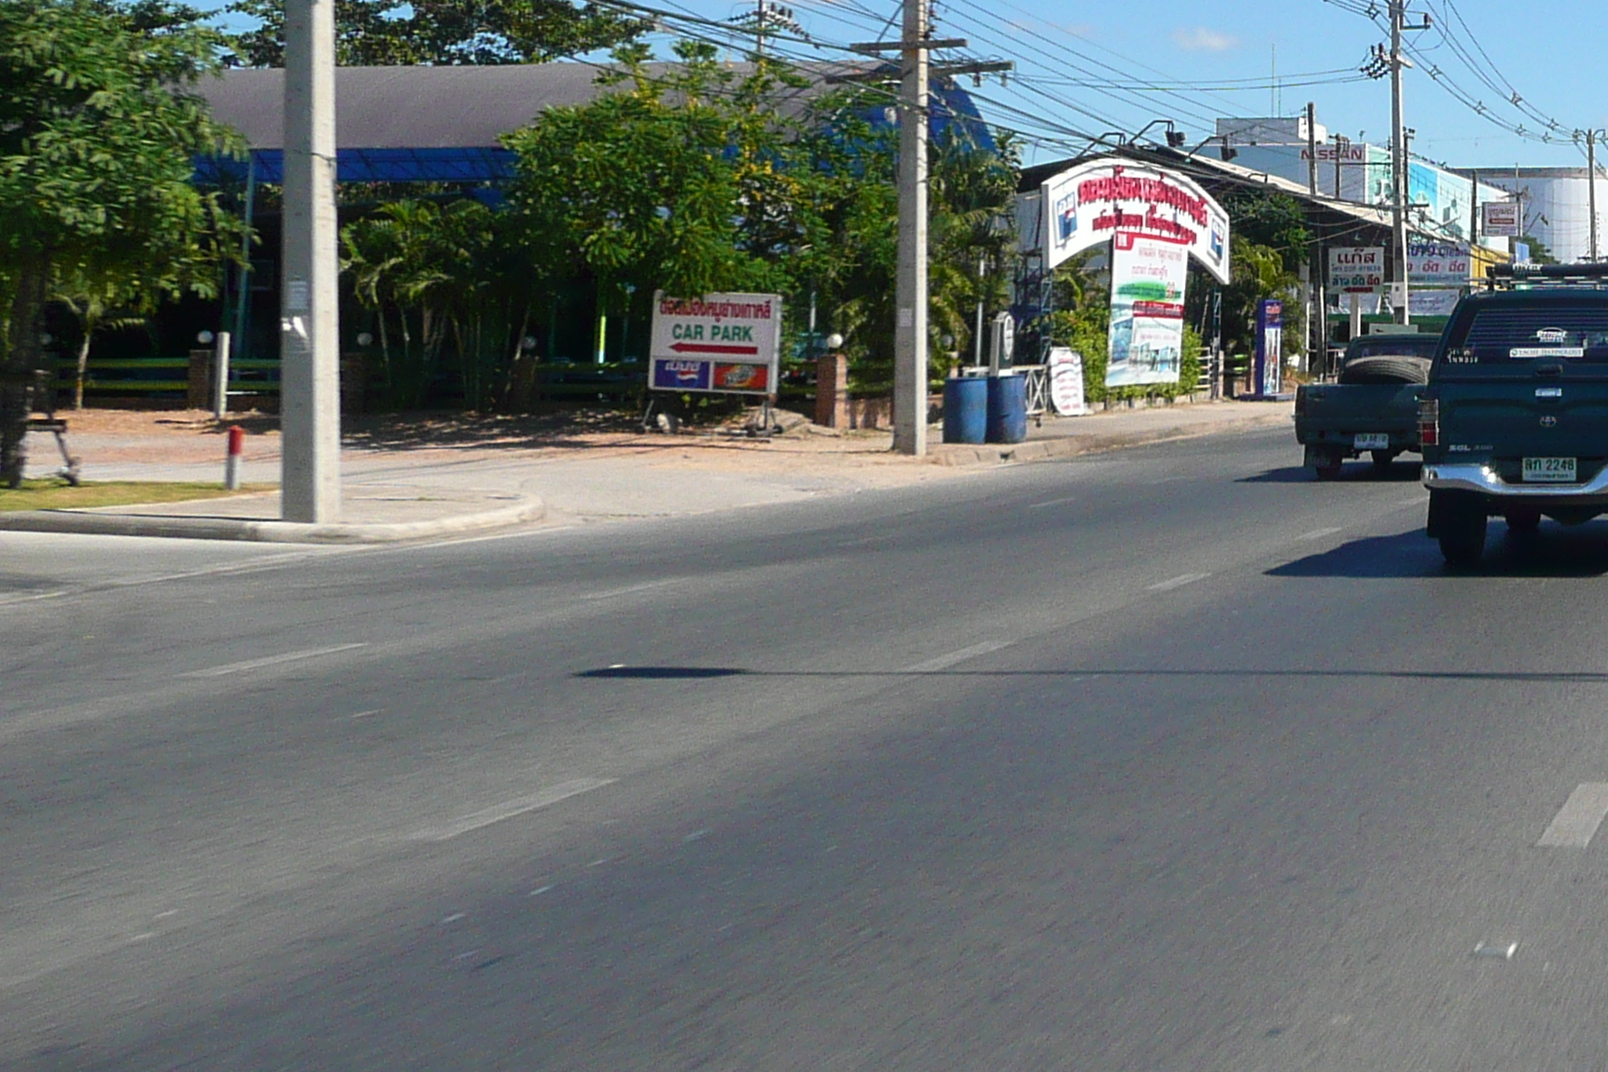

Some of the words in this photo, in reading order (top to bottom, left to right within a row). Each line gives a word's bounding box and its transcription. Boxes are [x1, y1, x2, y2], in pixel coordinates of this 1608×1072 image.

[1301, 149, 1363, 160] NSSAN
[672, 323, 704, 340] CAR
[711, 325, 753, 342] PARK
[1545, 458, 1575, 471] 2248
